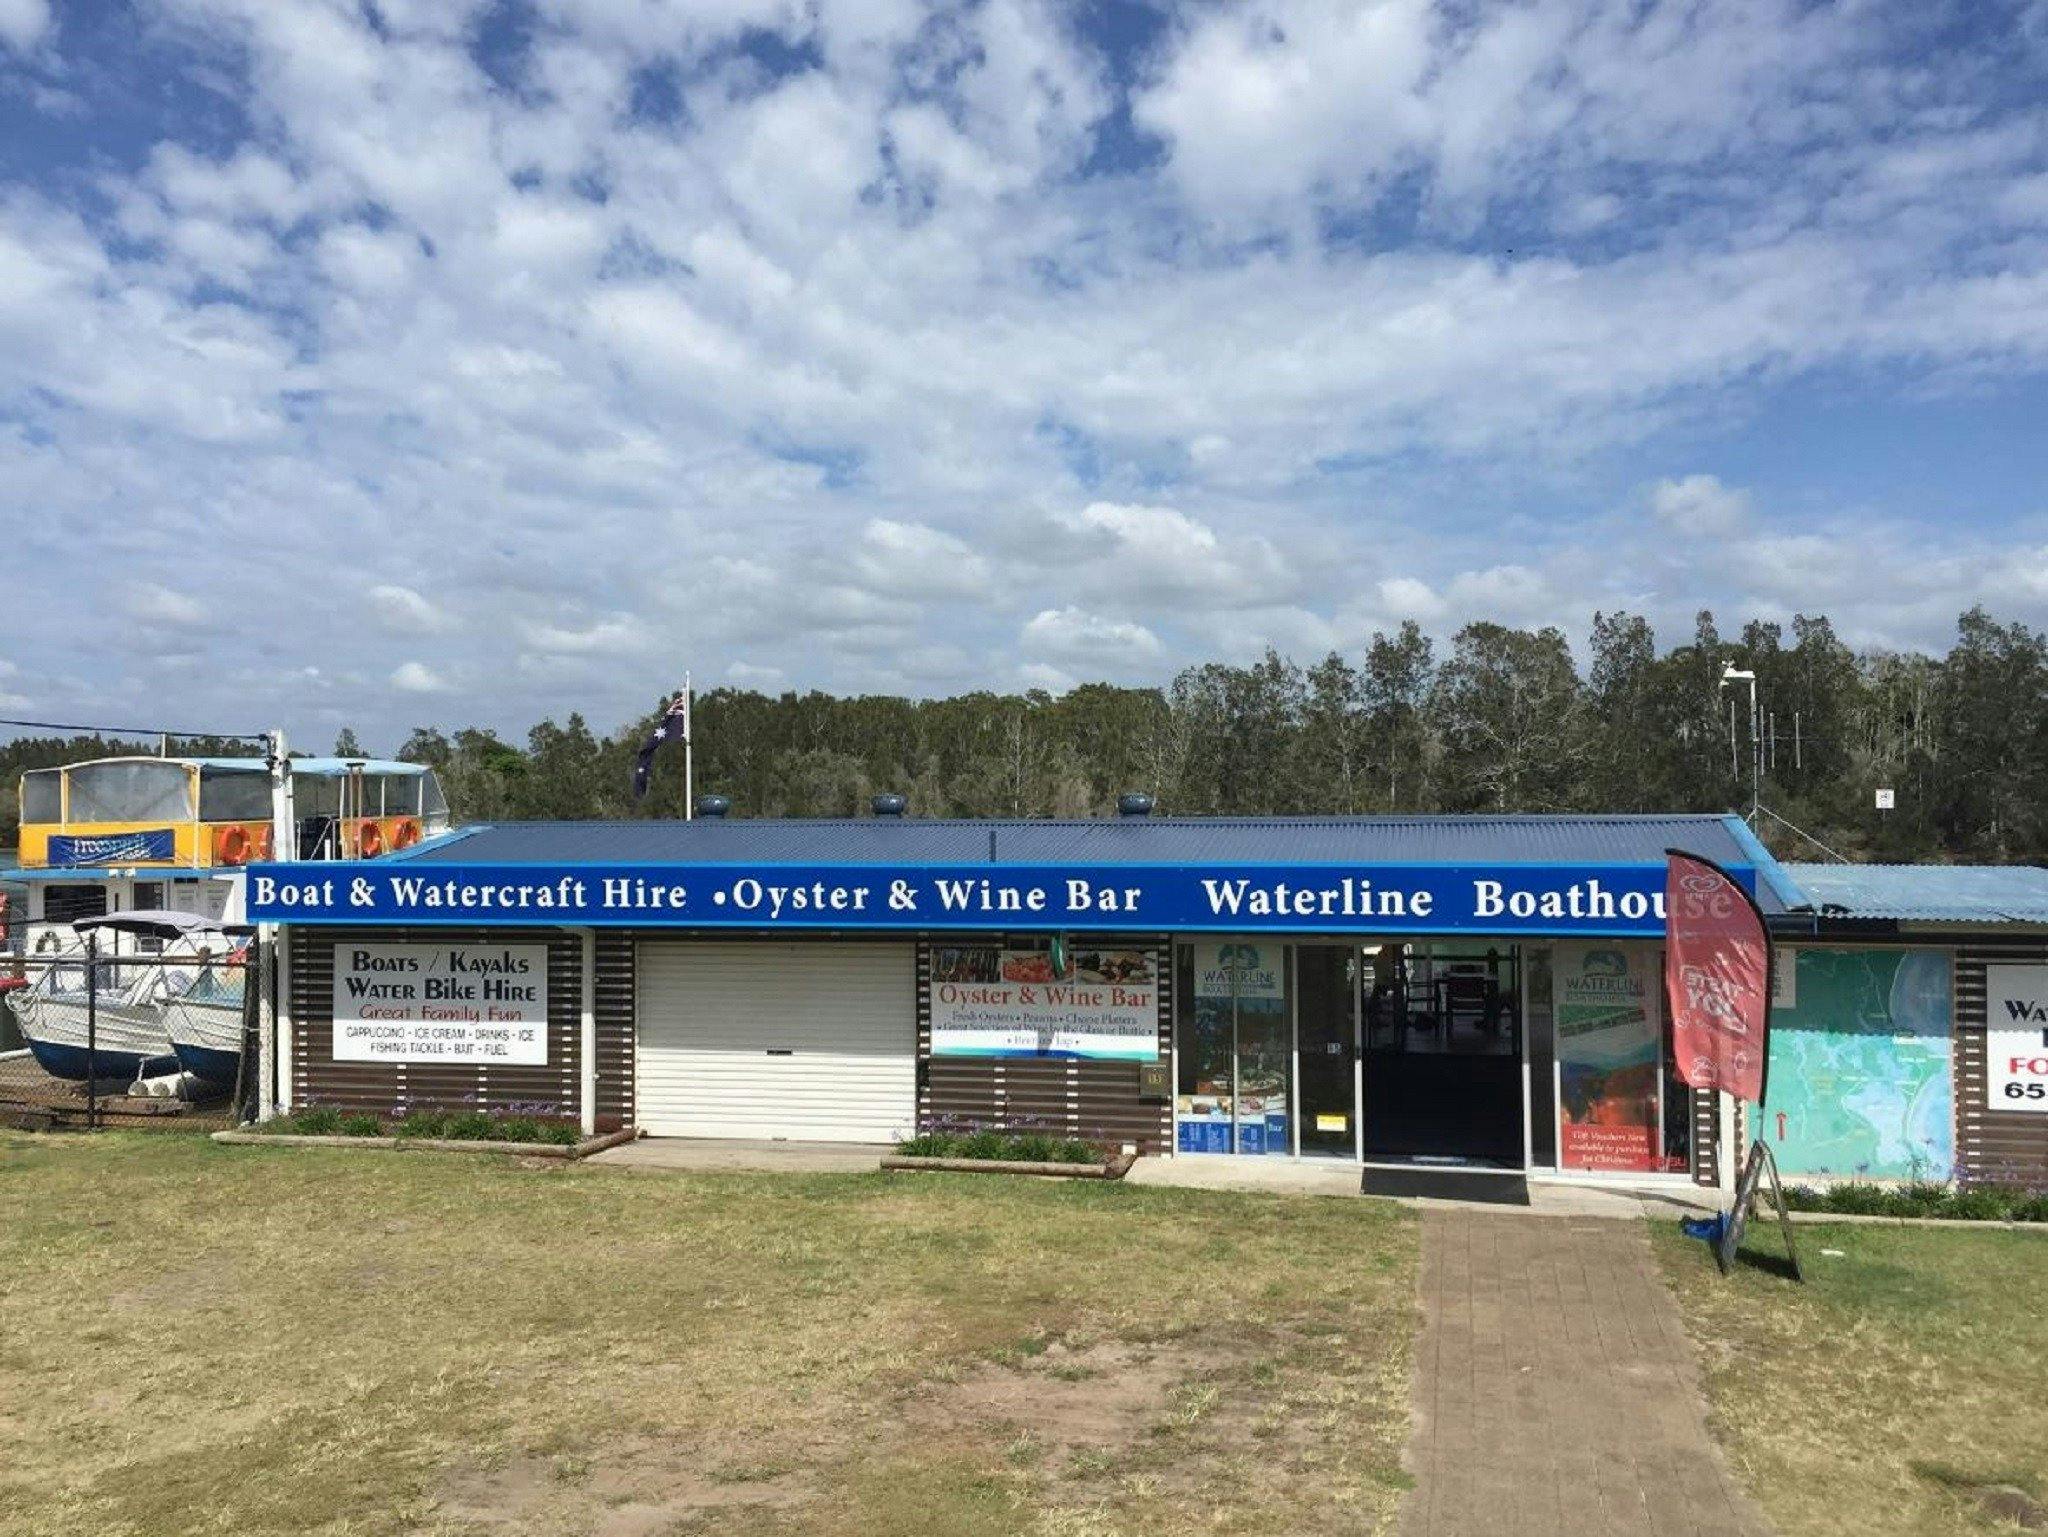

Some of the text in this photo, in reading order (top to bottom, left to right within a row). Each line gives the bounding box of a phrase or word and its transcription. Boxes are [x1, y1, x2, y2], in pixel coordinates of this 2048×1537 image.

[254, 876, 688, 908] Boat & Watercraft Hire
[888, 879, 918, 911] &
[935, 879, 1047, 911] Wine
[1066, 879, 1142, 911] Bar
[1201, 878, 1433, 918] Waterline
[1203, 970, 1275, 983] WATRLINE
[939, 985, 1152, 1010] Oyster & Wine Bar
[359, 1004, 523, 1025] Great Family Fun
[2004, 999, 2048, 1022] WA
[346, 1026, 535, 1042] CAPPUCCINO ICE CREAM DRINKS ICE
[370, 1043, 509, 1056] FISHING TACKLE BAIT FUEL
[2004, 1081, 2046, 1099] 65
